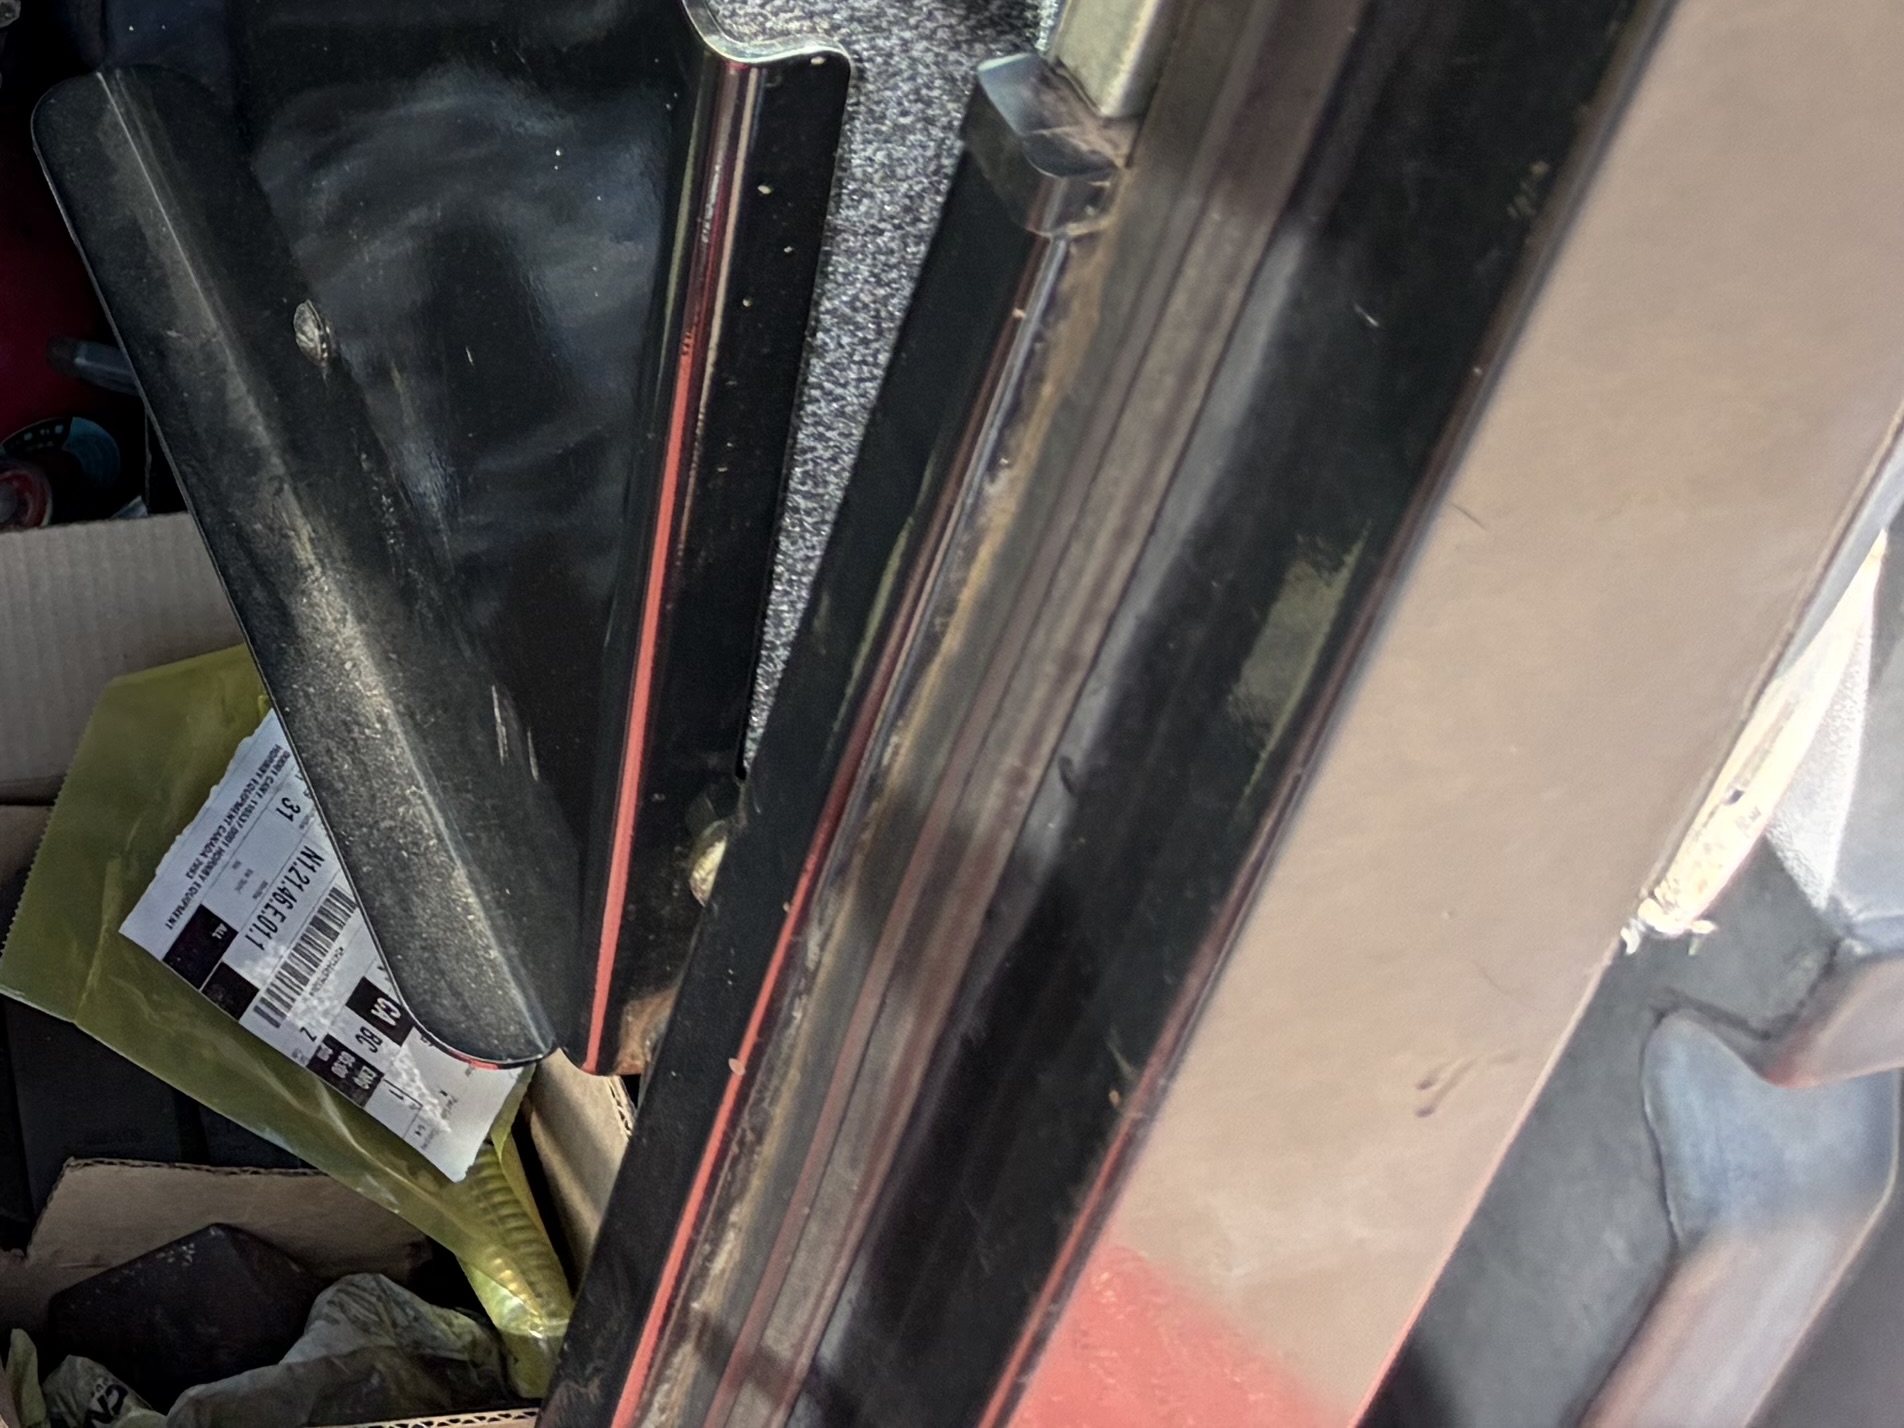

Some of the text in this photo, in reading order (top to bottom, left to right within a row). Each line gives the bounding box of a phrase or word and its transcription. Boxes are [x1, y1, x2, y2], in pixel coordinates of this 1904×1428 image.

[223, 777, 260, 826] EQUIPMENT
[275, 797, 302, 822] 31
[199, 825, 228, 859] CANADA
[200, 846, 226, 883] HORNBY
[164, 880, 203, 931] EQUIPMENT
[244, 844, 326, 952] N1.21.46.E.01.1
[211, 922, 229, 940] ALL
[370, 996, 403, 1027] CA
[355, 1025, 383, 1054] BC
